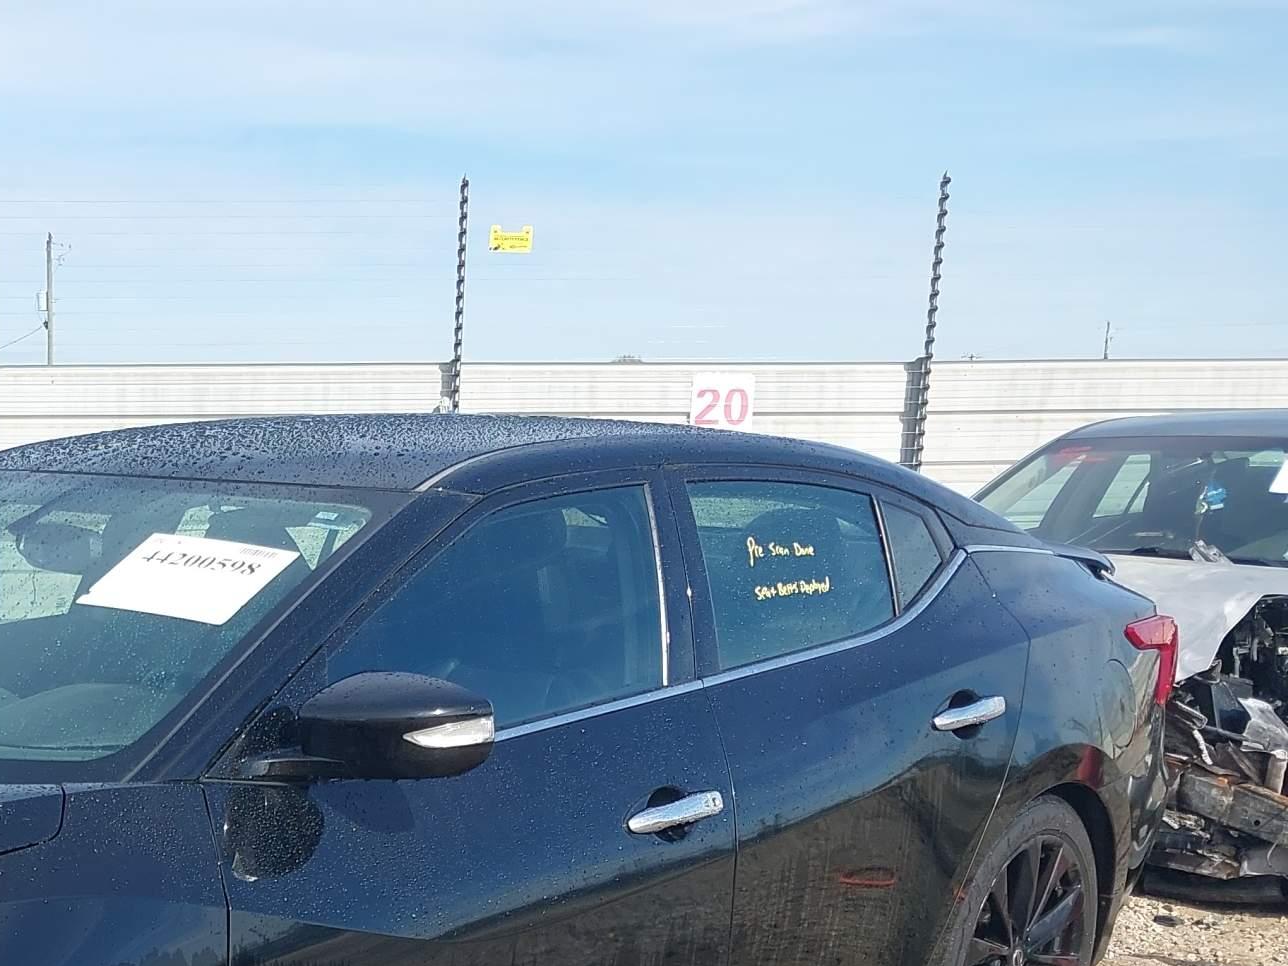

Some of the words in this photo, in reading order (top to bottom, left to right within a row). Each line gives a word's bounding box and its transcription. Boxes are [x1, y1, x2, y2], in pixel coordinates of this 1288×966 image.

[695, 388, 749, 426] 20
[141, 550, 262, 576] 44200598
[747, 537, 765, 567] Pre
[793, 542, 815, 556] Done
